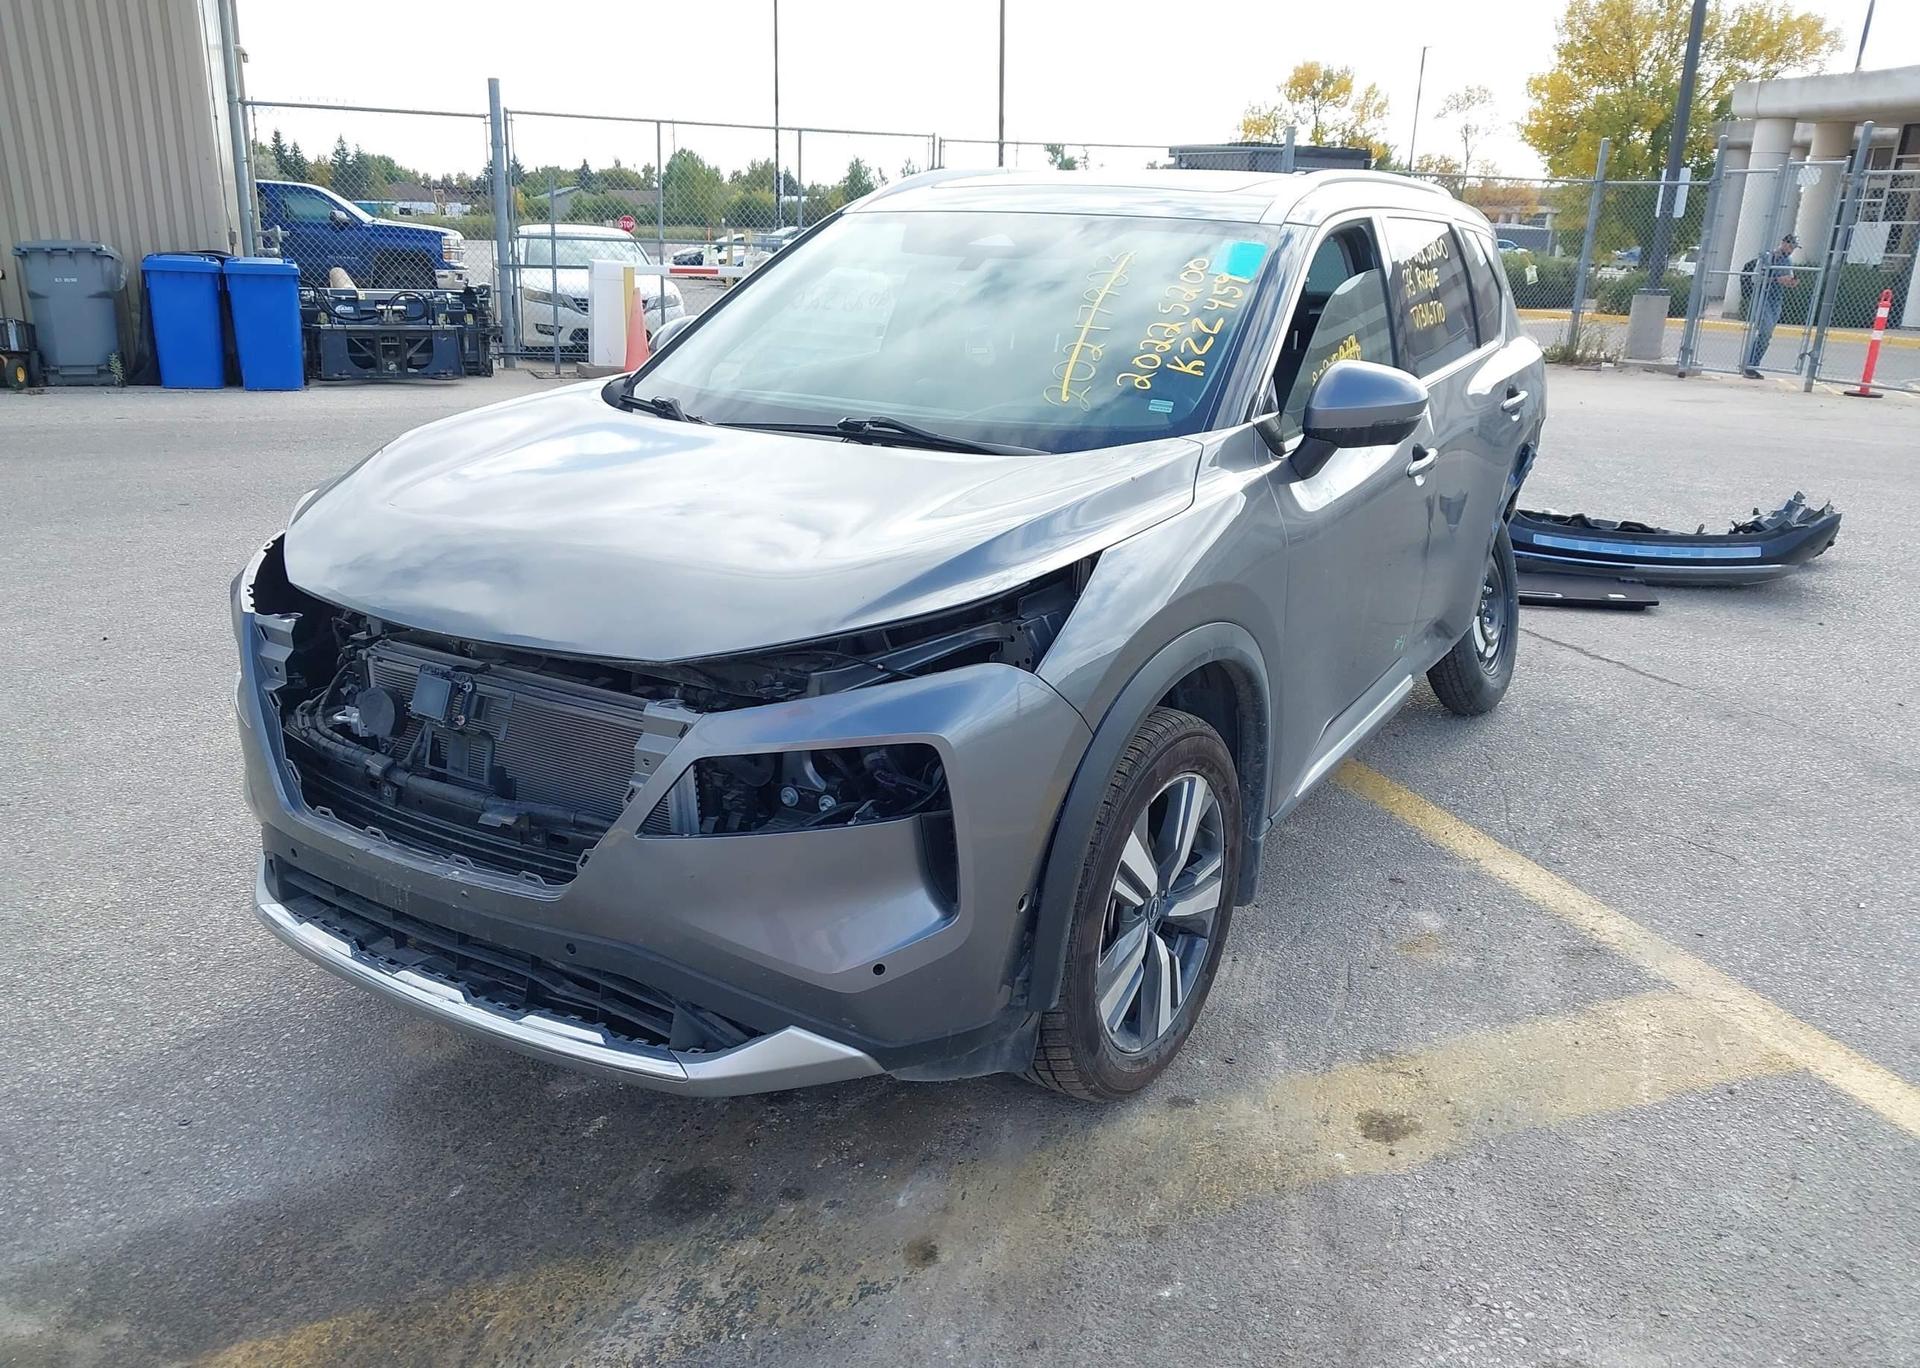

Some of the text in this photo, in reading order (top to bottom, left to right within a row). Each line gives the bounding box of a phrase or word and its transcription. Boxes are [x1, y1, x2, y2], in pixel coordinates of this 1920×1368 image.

[619, 221, 634, 229] STOP
[1116, 258, 1209, 389] 20225200
[1167, 272, 1250, 376] KZZ 459
